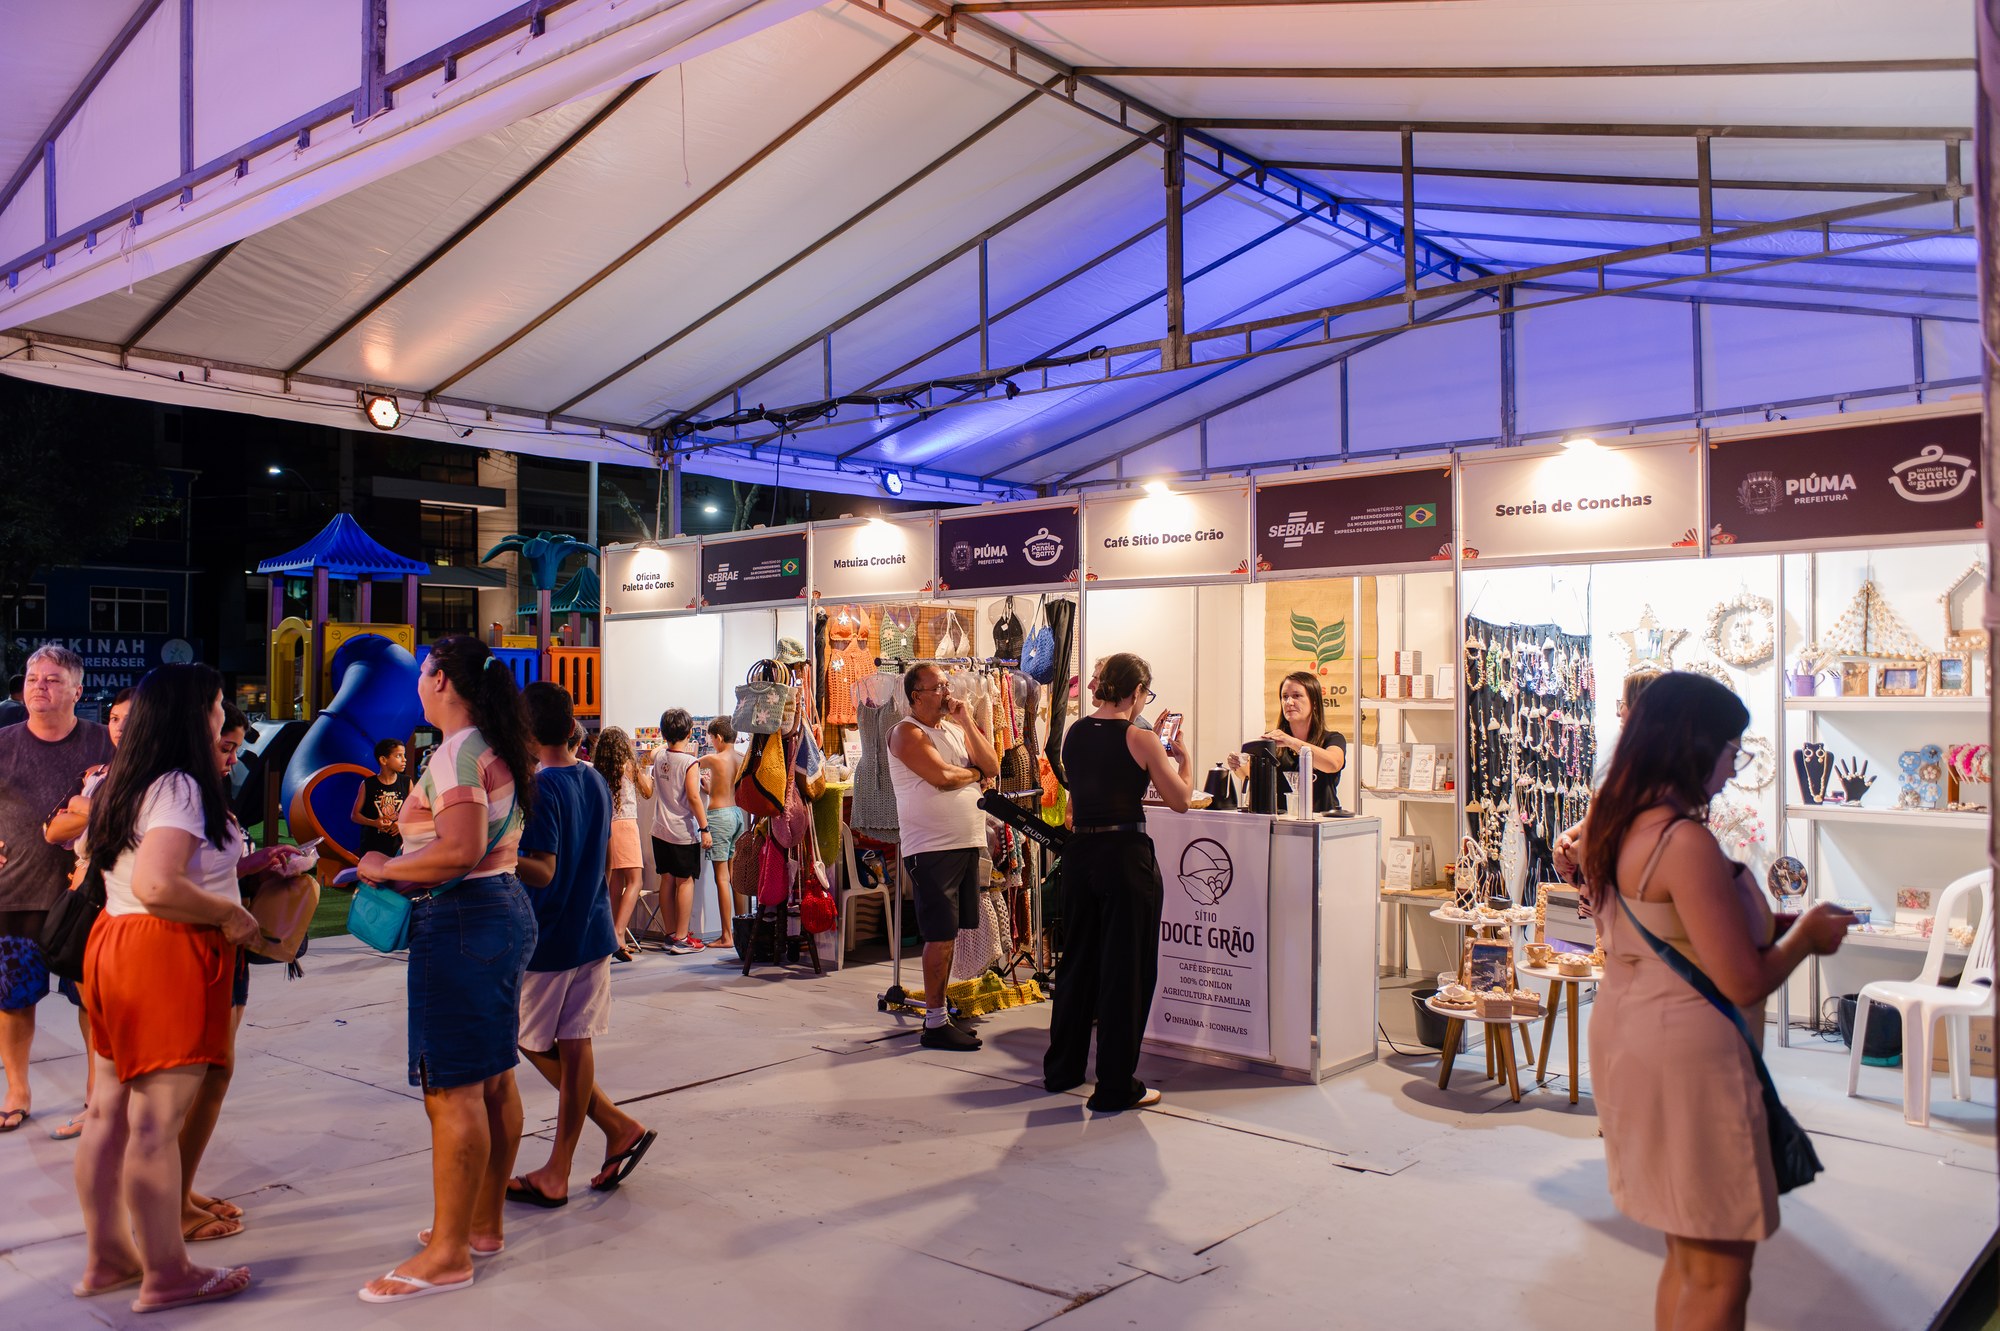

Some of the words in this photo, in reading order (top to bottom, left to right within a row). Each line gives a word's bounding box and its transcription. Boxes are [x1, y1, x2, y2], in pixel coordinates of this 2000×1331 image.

[1907, 466, 1957, 481] Panela
[1785, 472, 1857, 496] PIÚMA
[1916, 478, 1958, 491] Barro
[1495, 500, 1547, 517] Sereia
[1551, 499, 1572, 513] de
[1577, 494, 1652, 511] Conchas
[1794, 493, 1848, 505] PREFEITURA
[1268, 521, 1325, 538] SEBRAE
[1104, 536, 1129, 548] Café
[1132, 534, 1159, 546] Sítio
[1162, 533, 1192, 544] Doce
[1195, 529, 1224, 542] Grão
[974, 543, 1008, 559] PIÚMA
[1031, 542, 1055, 552] Panela
[833, 556, 868, 569] Matuiza
[870, 554, 906, 566] Crochêt
[1035, 550, 1055, 559] Barro
[636, 572, 660, 581] Oficina
[707, 571, 739, 583] SEBRAE
[622, 583, 644, 592] Paleta
[645, 582, 653, 590] de
[655, 581, 674, 589] Cores
[1330, 686, 1347, 695] DO
[1323, 698, 1340, 708] SIL
[1194, 909, 1217, 923] SÍTIO
[1161, 921, 1203, 947] DOCE
[1208, 926, 1254, 958] GRÃO
[1179, 962, 1197, 972] CAFÉ
[1198, 965, 1233, 977] ESPECIAL
[1180, 976, 1198, 986] 100%
[1198, 979, 1232, 990] CONILON
[1163, 986, 1213, 1001] AGRICULTURA
[1214, 994, 1251, 1007] FAMILIAR
[1172, 1016, 1204, 1028] INHAÚMA
[1209, 1022, 1248, 1036] ICONHA/ES
